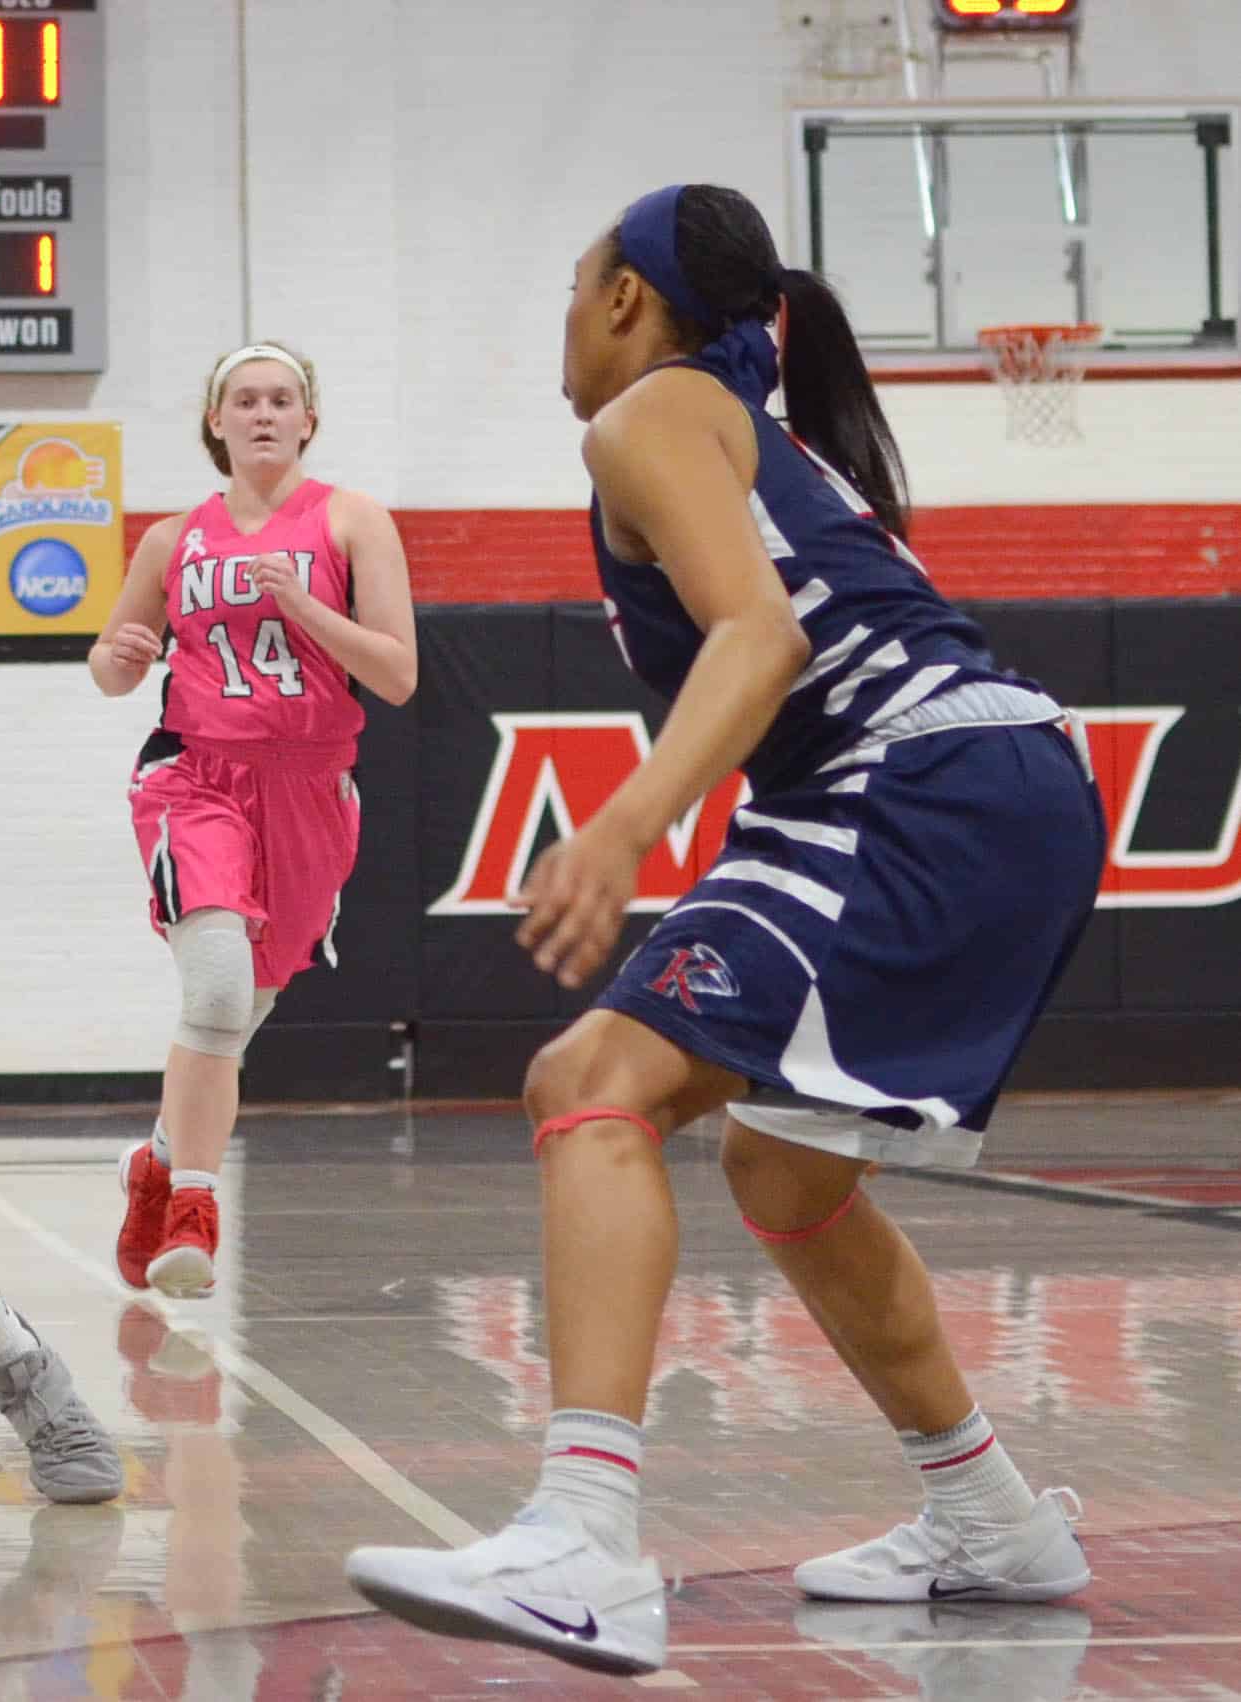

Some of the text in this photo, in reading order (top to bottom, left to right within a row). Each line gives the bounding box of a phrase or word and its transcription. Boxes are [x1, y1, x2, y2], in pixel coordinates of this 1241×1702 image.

[38, 235, 53, 292] 1
[16, 575, 87, 599] NCAA
[207, 619, 305, 698] 14
